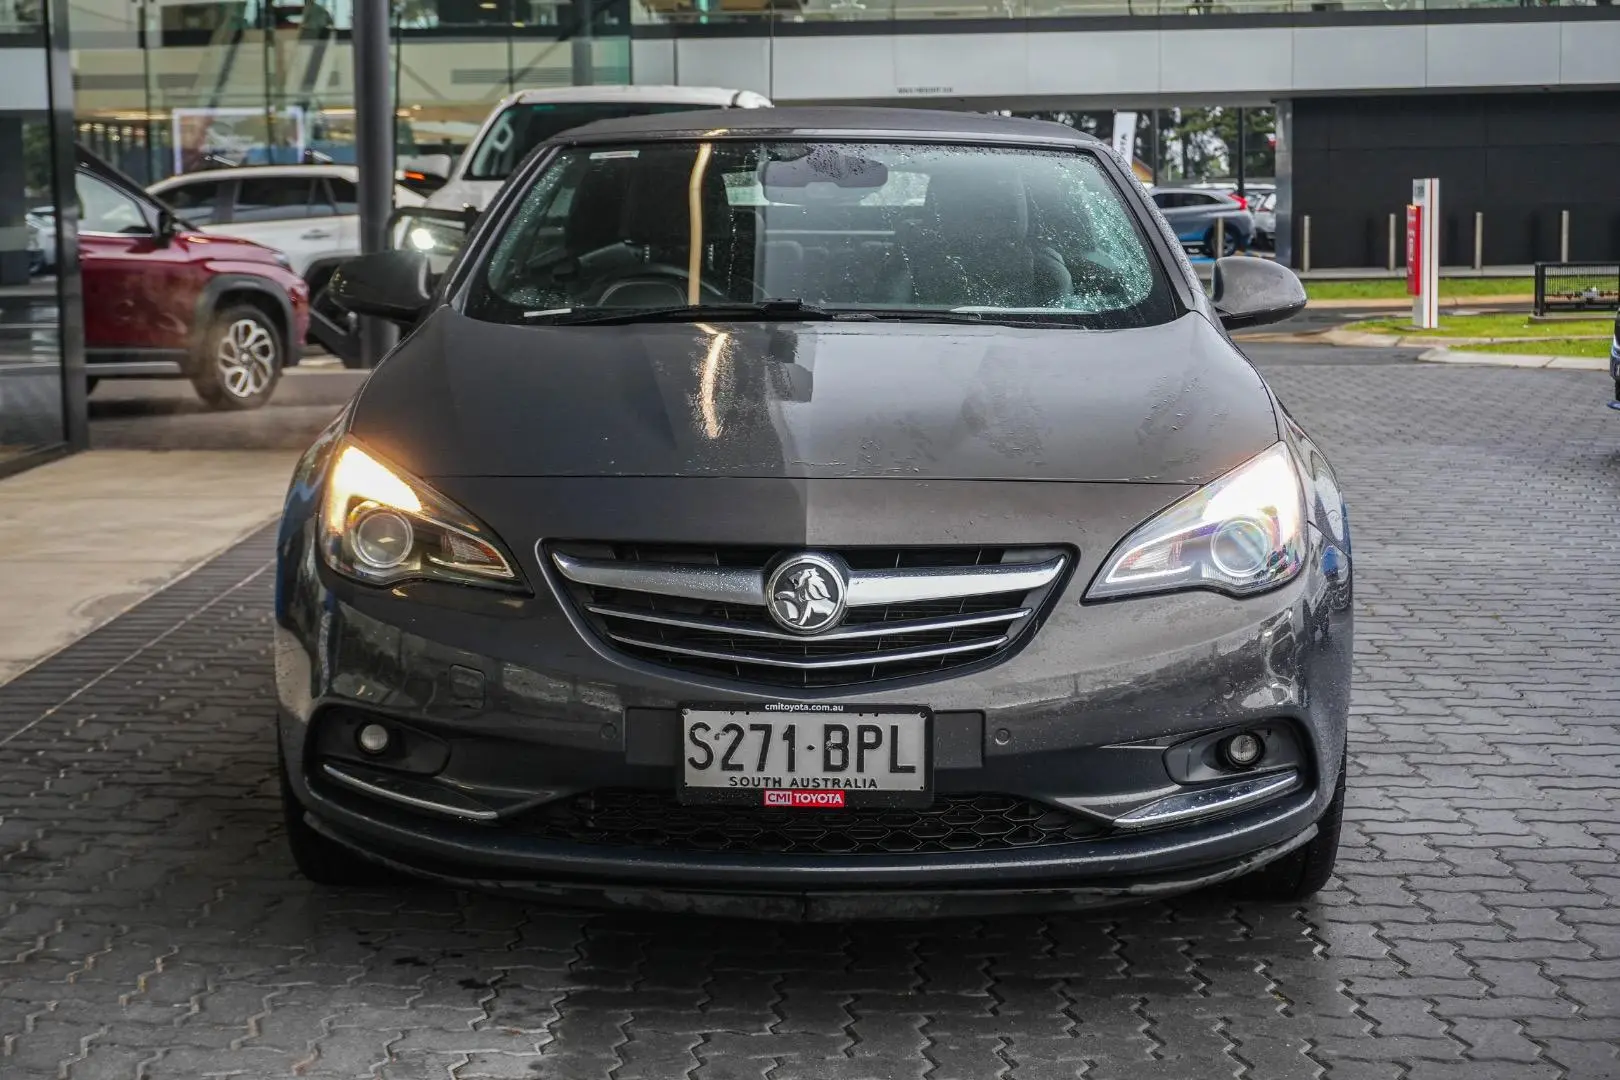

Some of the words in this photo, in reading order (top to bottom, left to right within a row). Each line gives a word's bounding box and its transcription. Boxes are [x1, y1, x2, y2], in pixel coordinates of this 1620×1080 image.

[764, 702, 844, 713] cmitoyota.com.au
[729, 776, 782, 788] SOUTH
[790, 777, 878, 789] AUSTRALIA
[767, 792, 791, 804] CMI
[793, 793, 843, 805] TOYOTA
